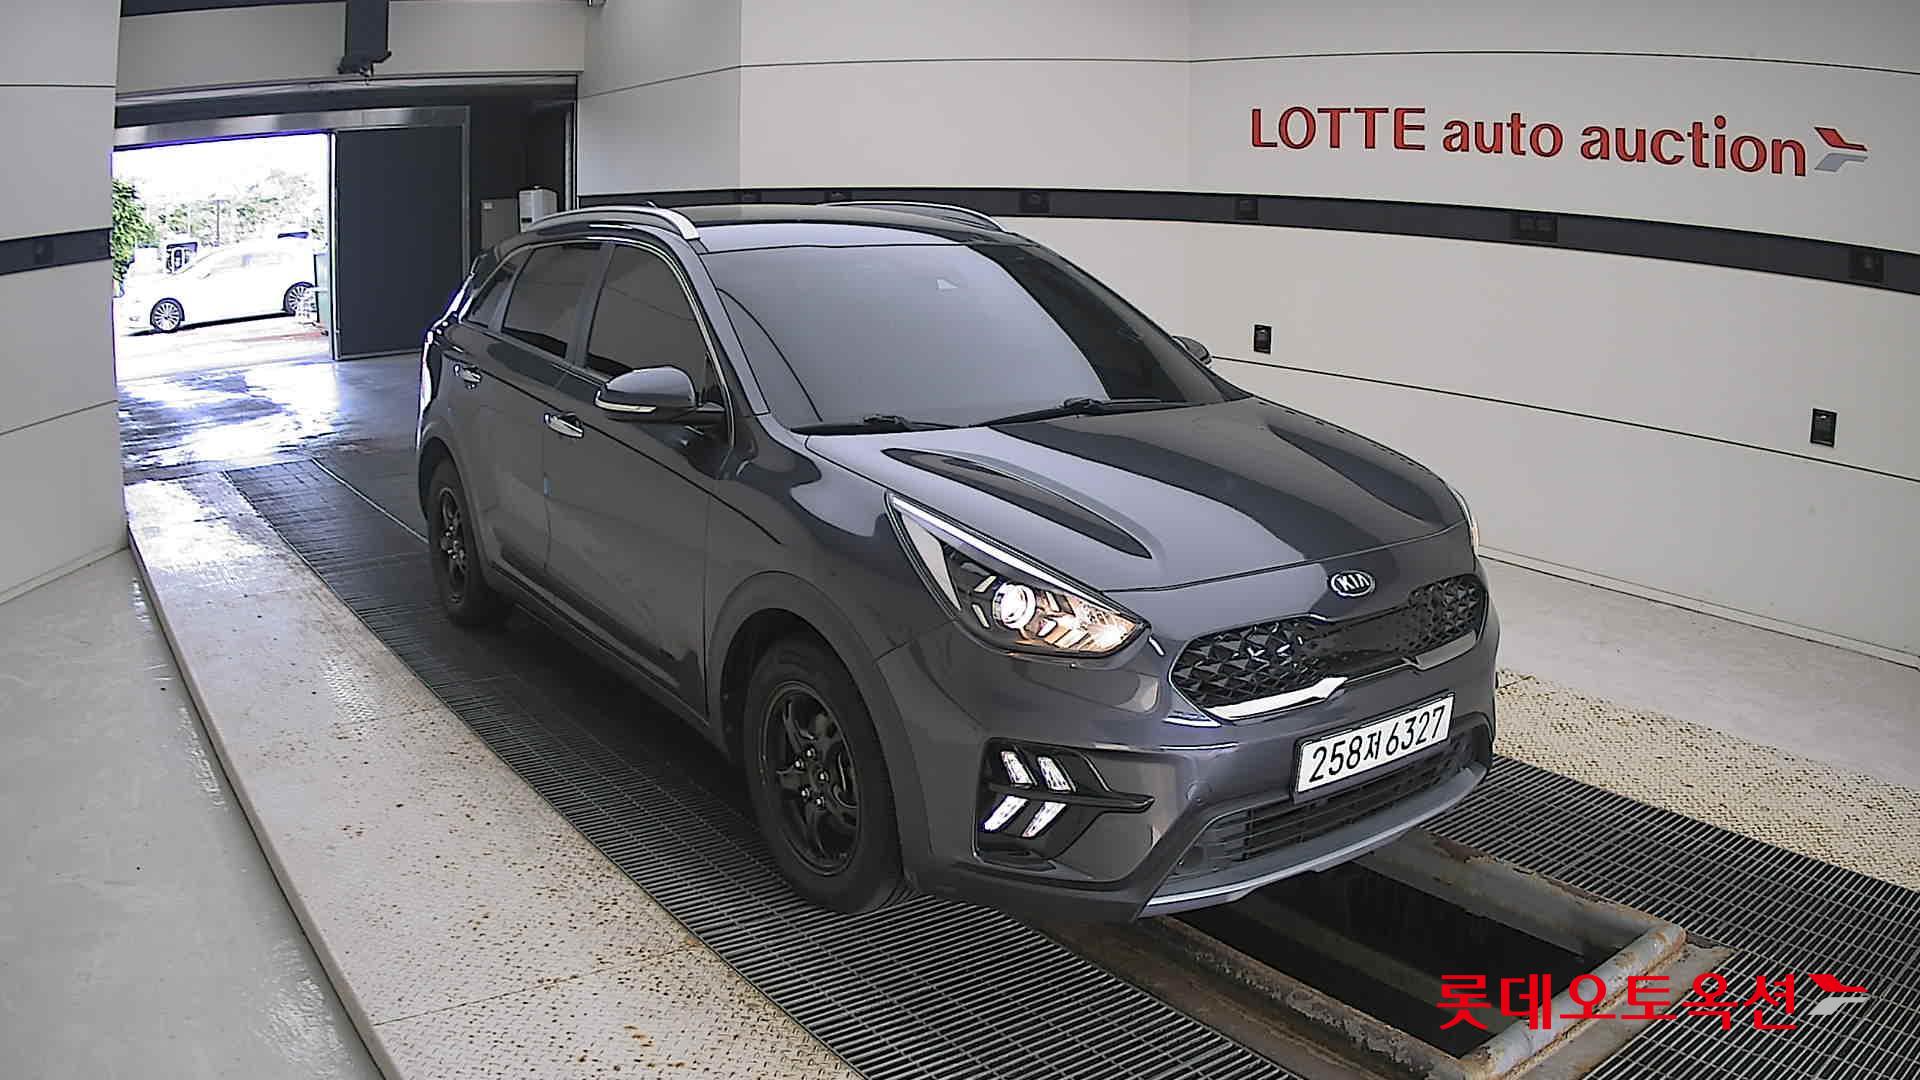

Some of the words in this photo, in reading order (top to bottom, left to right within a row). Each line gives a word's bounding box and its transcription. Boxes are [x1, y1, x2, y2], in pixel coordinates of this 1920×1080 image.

[1251, 107, 1424, 150] LOTTE
[1443, 114, 1563, 156] auto
[1580, 116, 1806, 175] auction
[1336, 573, 1370, 591] KIA
